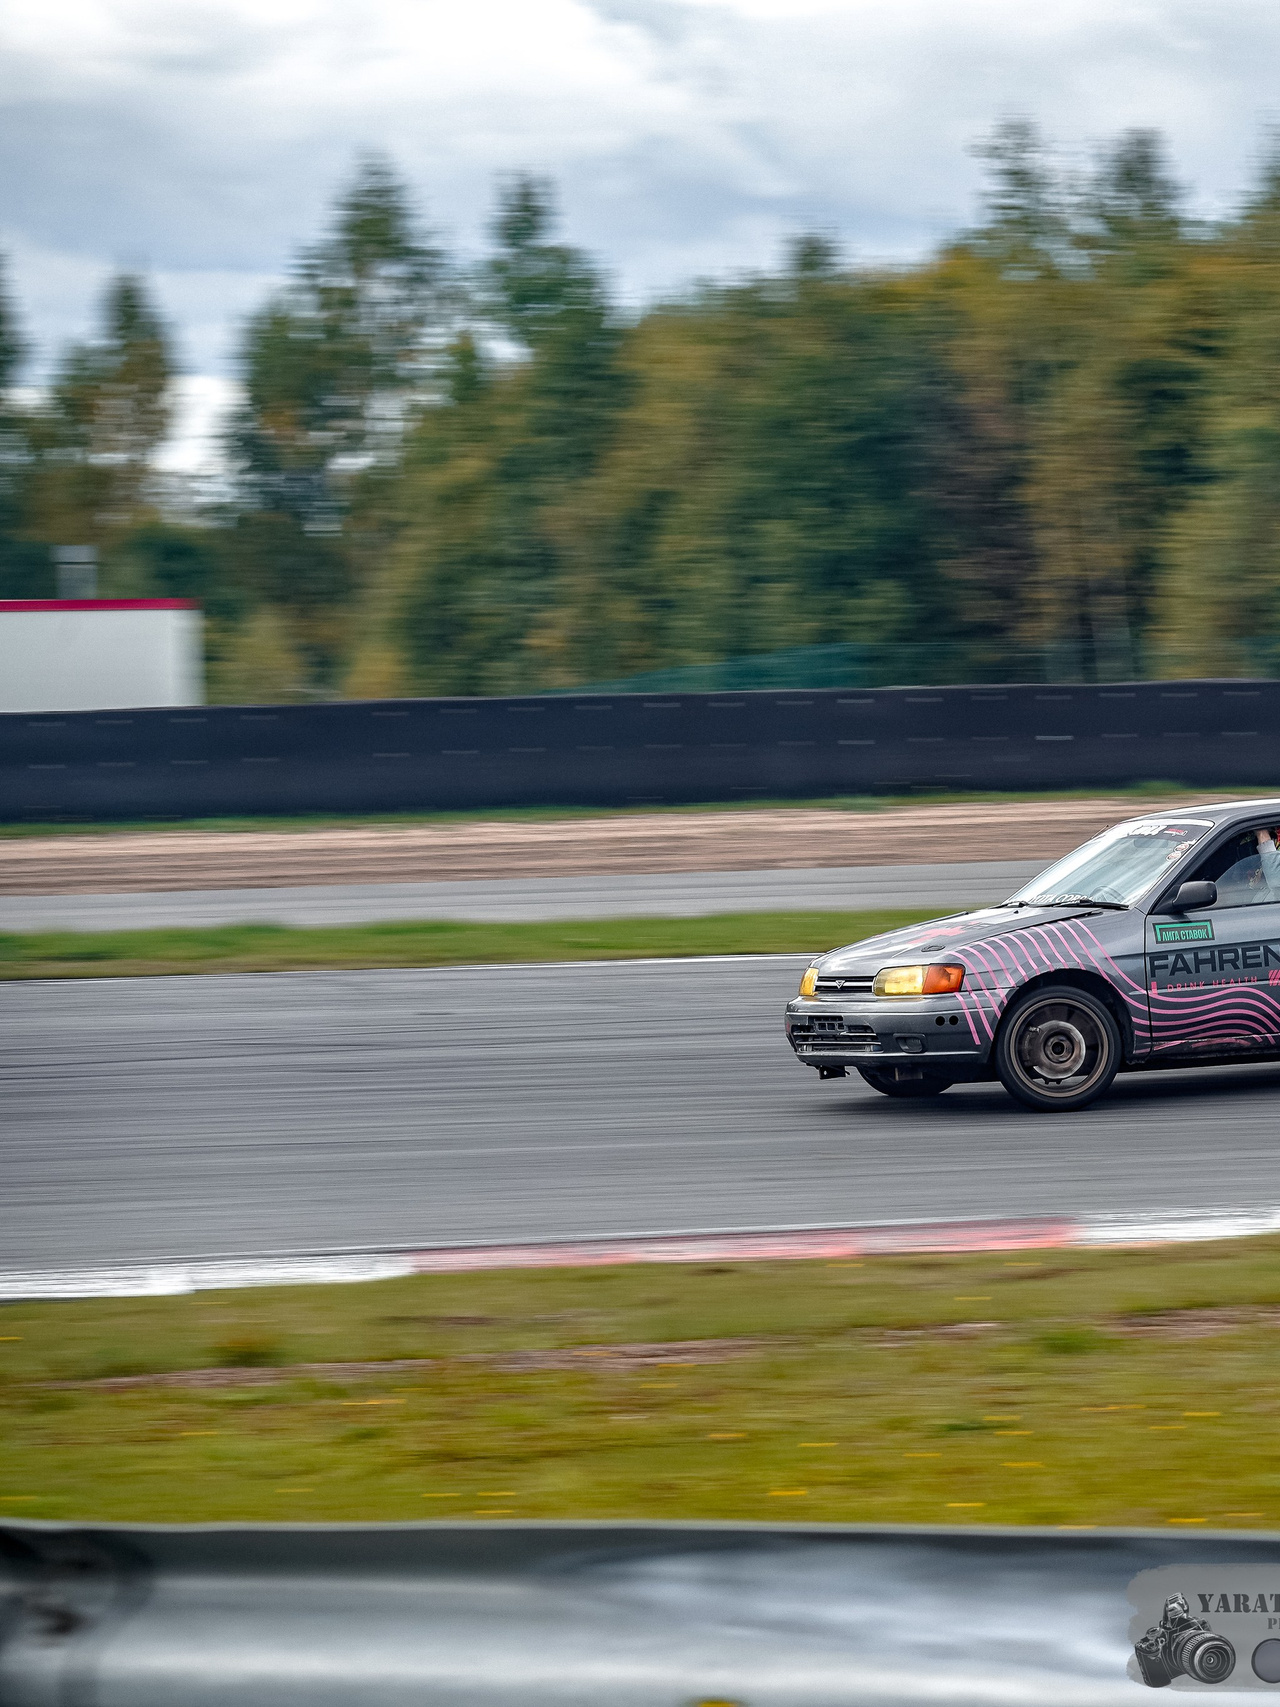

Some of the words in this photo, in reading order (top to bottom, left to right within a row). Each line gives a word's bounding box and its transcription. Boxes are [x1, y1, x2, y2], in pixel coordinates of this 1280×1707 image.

[1162, 930, 1180, 942] ЛИГА
[1180, 928, 1208, 940] СТАВОК
[1167, 981, 1205, 993] DRINK
[1212, 976, 1258, 988] HEALTH
